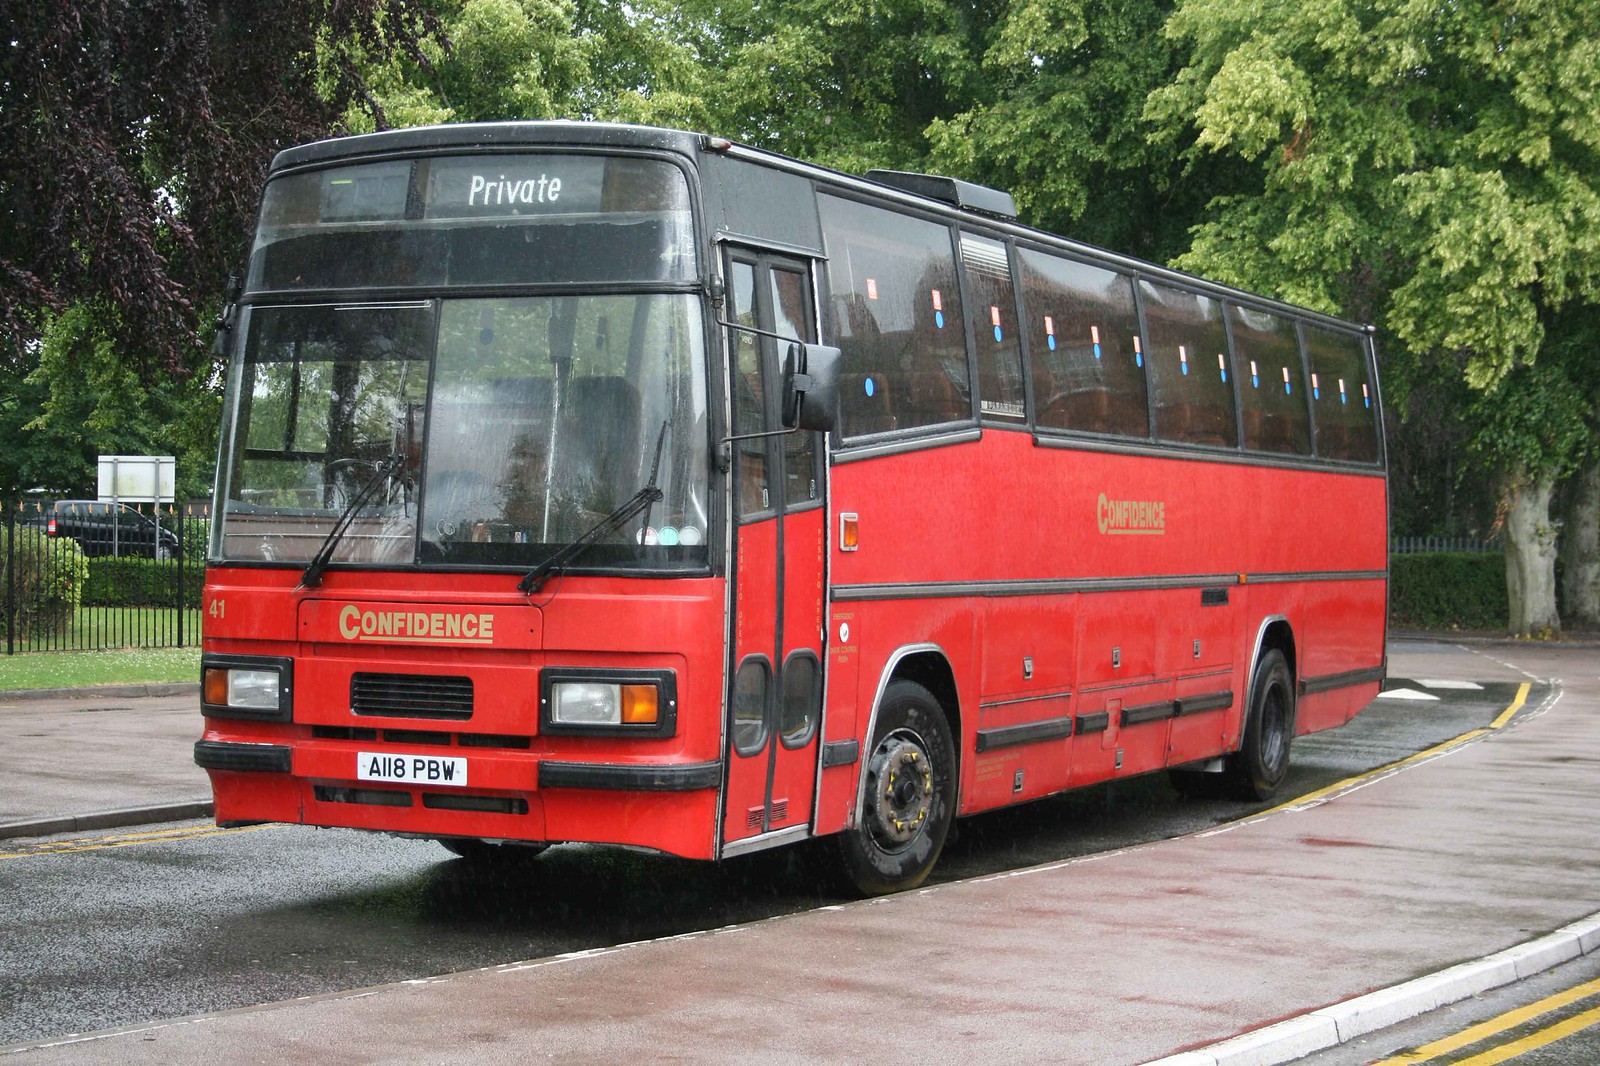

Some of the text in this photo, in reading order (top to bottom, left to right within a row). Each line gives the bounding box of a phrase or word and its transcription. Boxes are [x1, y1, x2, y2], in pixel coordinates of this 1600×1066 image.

[469, 174, 561, 206] Private
[1097, 491, 1165, 535] CONFIDENCE
[209, 599, 225, 619] 41
[339, 604, 494, 640] CONFIDENCE
[369, 757, 455, 781] A118 PBW
